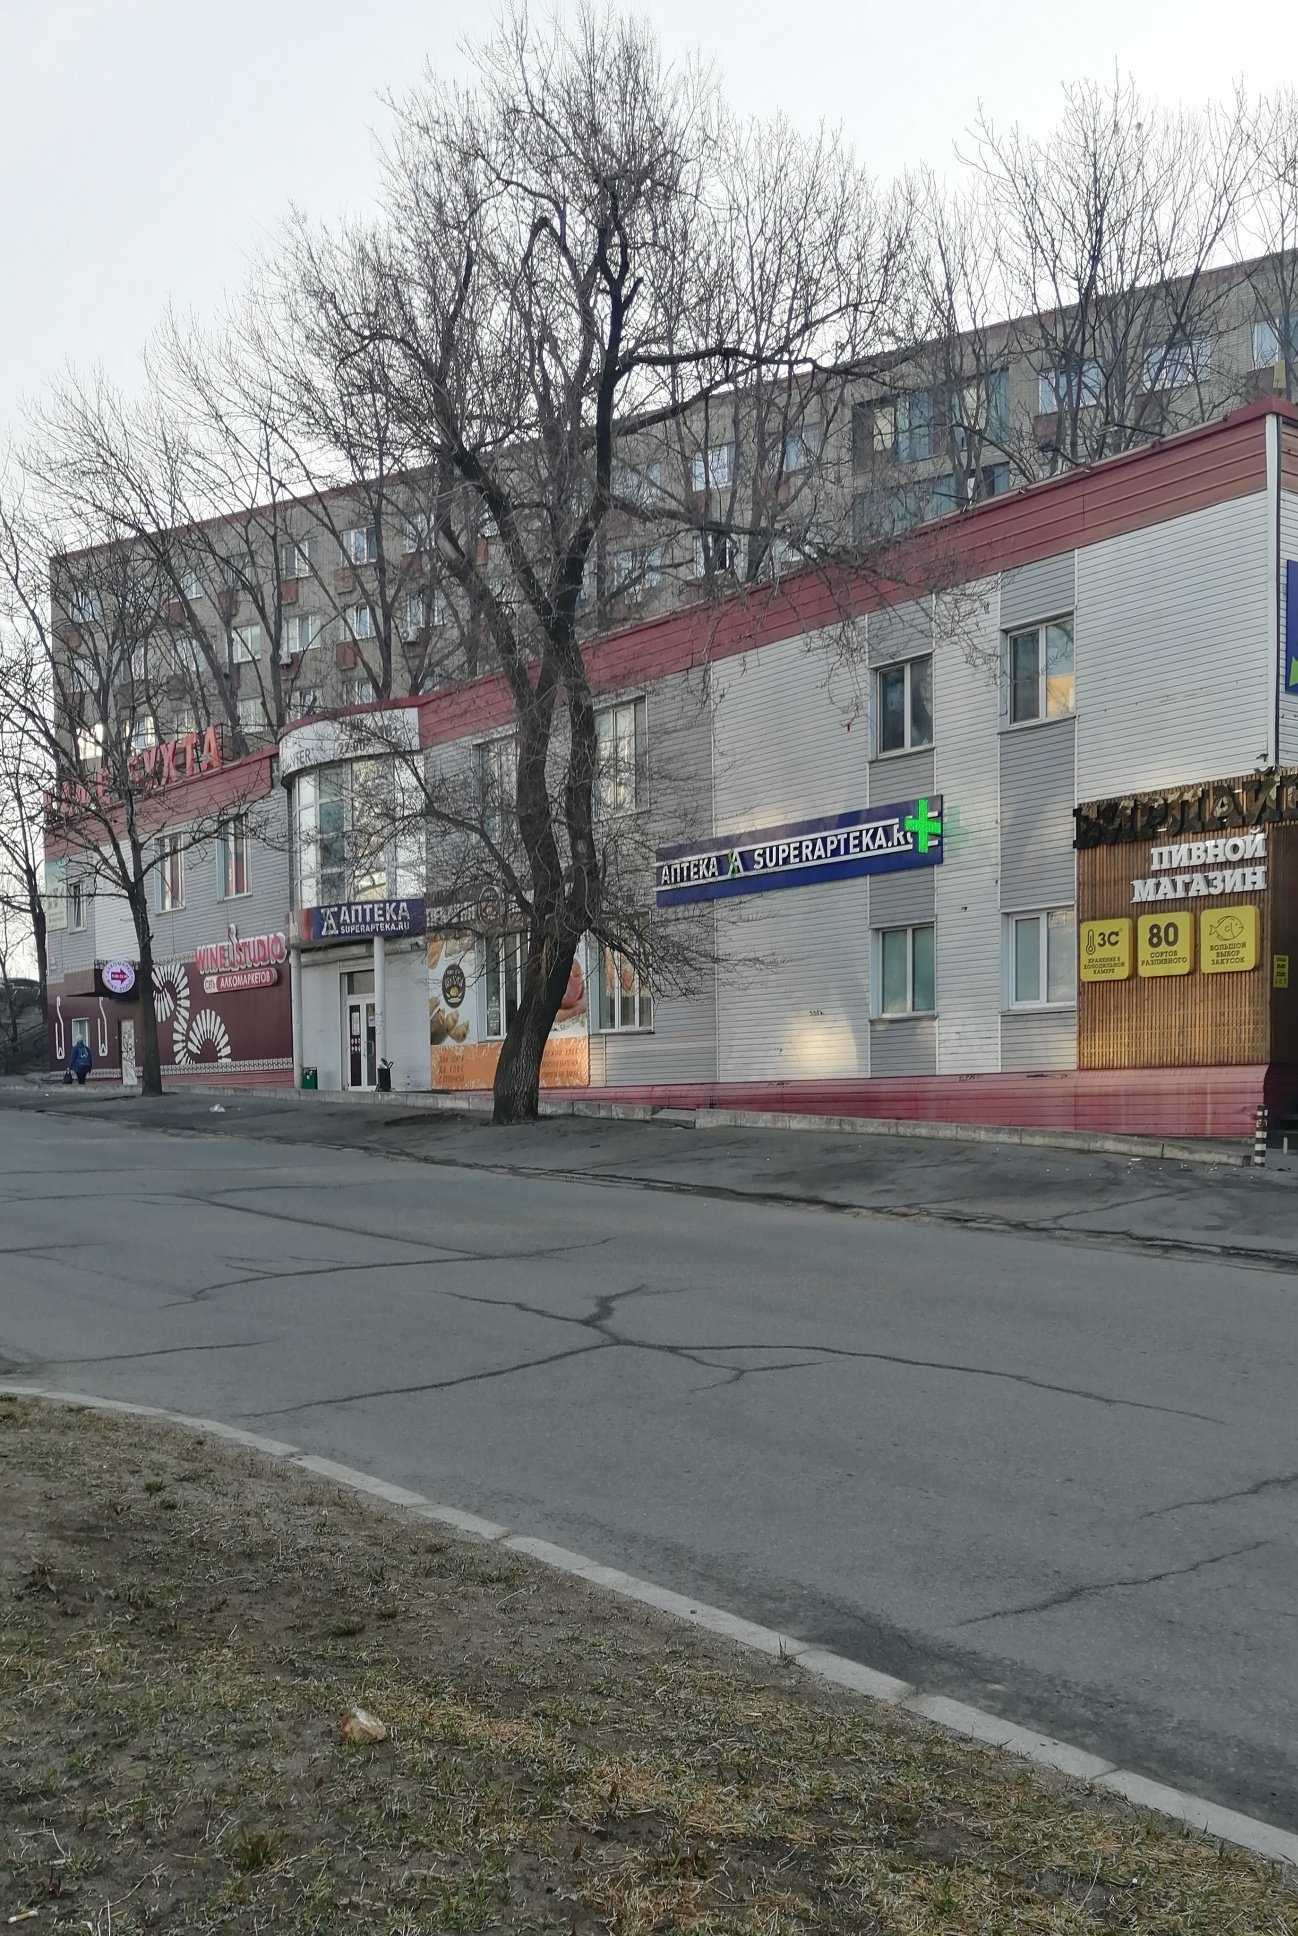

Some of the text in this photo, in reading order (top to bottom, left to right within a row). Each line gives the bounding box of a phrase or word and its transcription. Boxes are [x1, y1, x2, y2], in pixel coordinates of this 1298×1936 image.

[1150, 826, 1267, 870] ПИВНОЙ
[661, 857, 719, 885] АПТЕКА
[1130, 866, 1268, 903] МАГАЗИН
[340, 902, 410, 924] АПТЕКА
[340, 922, 410, 934] SUPERAPTEKA.RU
[1148, 922, 1179, 949] 80
[1140, 957, 1188, 967] РАЗЛИВНОГО
[1150, 950, 1178, 959] СОРТОВ
[1211, 957, 1246, 966] ЗАКУСОК
[220, 970, 271, 989] АЛКОМАРКЕТОВ
